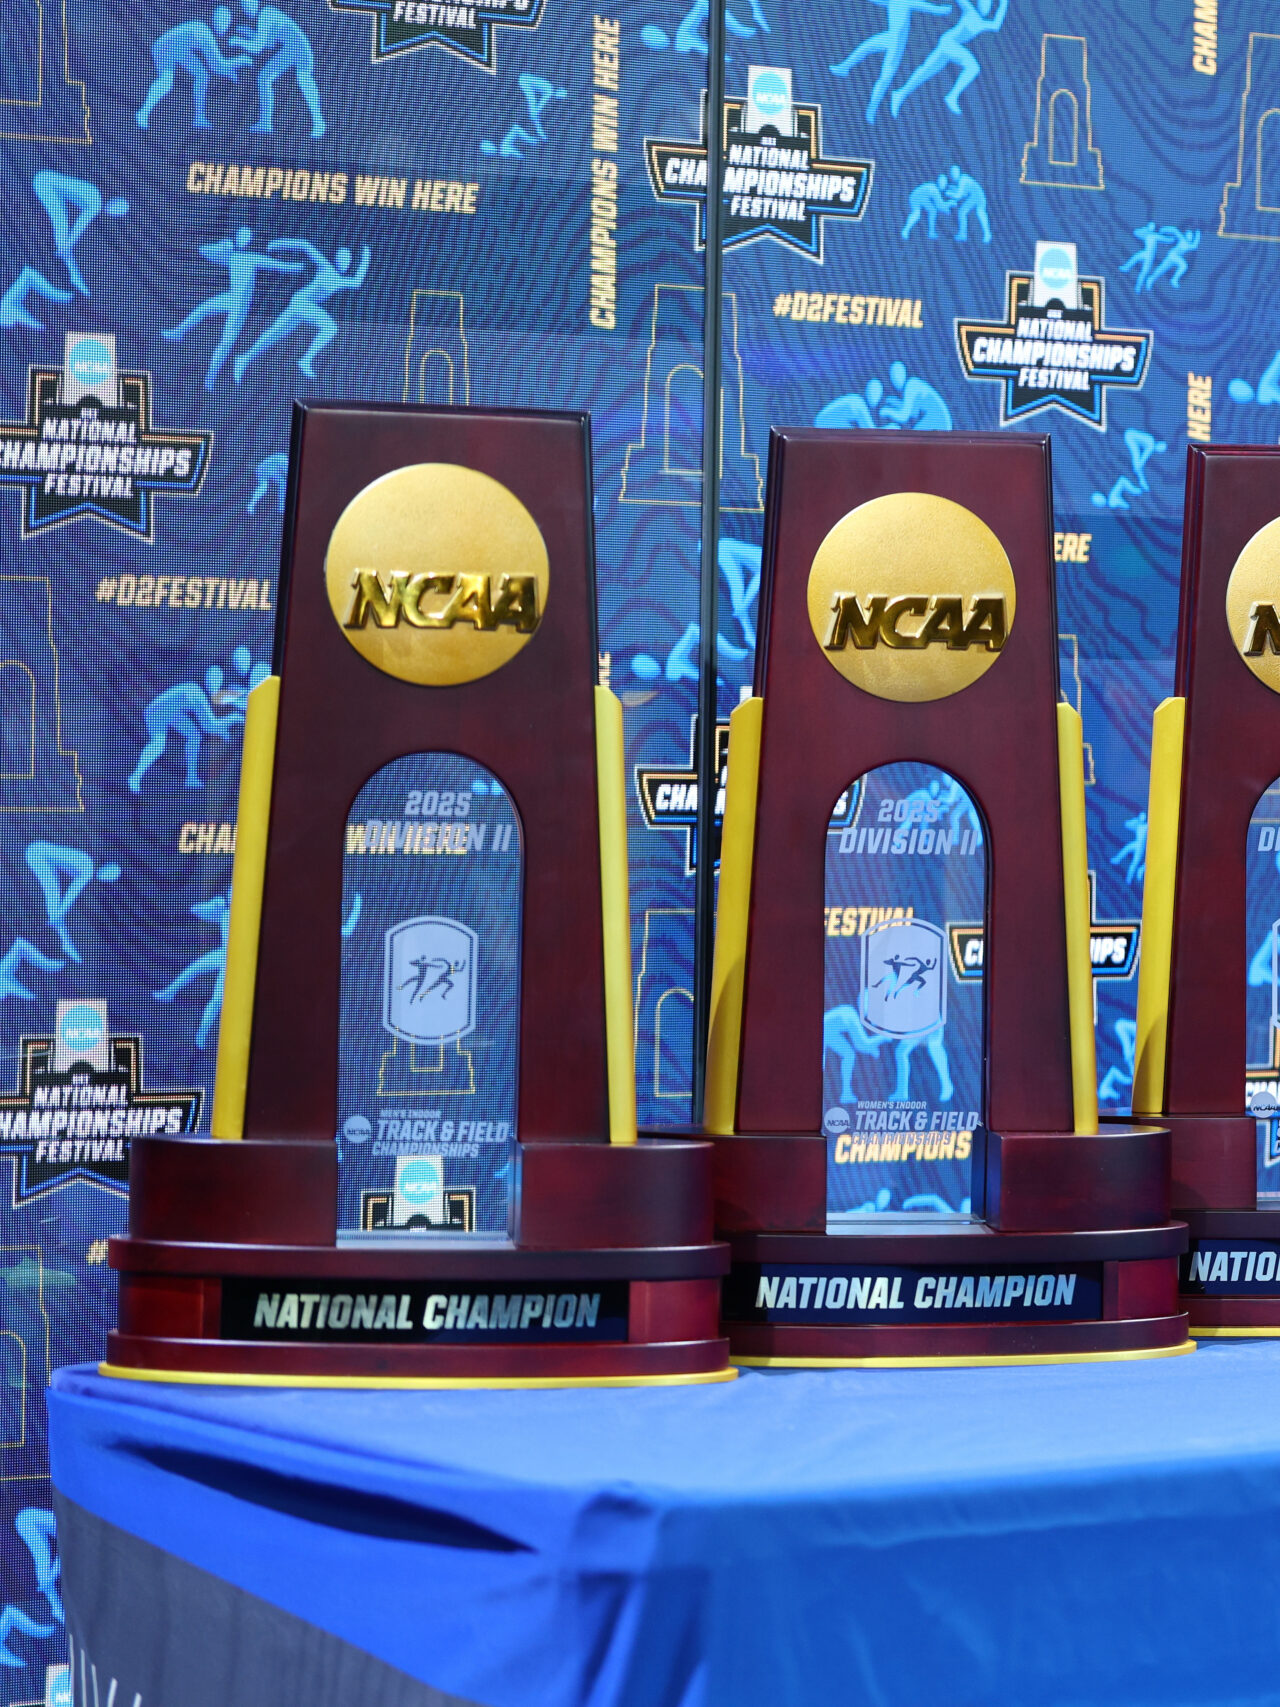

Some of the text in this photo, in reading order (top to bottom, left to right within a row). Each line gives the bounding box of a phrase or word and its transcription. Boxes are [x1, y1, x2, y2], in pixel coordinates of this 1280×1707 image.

[394, 2, 476, 28] FESTIVAL
[729, 144, 811, 171] NATIONAL
[590, 14, 621, 330] CHAMPIONS WIN HERE
[665, 157, 856, 203] CHAMPIONSHIPS
[187, 161, 480, 214] CHAMPIONS WIN HERE
[731, 195, 806, 221] FESTIVAL
[773, 292, 923, 329] #D2FESTIVAL
[1017, 317, 1093, 342] NATIONAL
[973, 337, 1136, 371] CHAMPIONSHIPS
[1018, 367, 1090, 391] FESTIVAL
[1187, 372, 1212, 442] HERE
[42, 418, 137, 444] NATIONAL
[45, 473, 135, 498] FESTIVAL
[1054, 532, 1092, 562] ERE
[96, 574, 272, 610] #D2FESTIVAL
[343, 567, 542, 634] NCAA
[823, 591, 1008, 652] NCAA
[404, 790, 472, 817] 2025
[877, 799, 941, 823] 2025
[364, 819, 512, 852] DIVISION II
[838, 827, 978, 855] DIVISION II
[34, 1086, 128, 1108] NATIONAL
[858, 1100, 928, 1110] WOMEN'S INDOOR
[0, 1108, 183, 1136] HAMPIONSHIPS
[376, 1120, 510, 1143] TRACK & FIELD
[855, 1110, 979, 1131] TRACK & FIELD
[35, 1139, 125, 1163] FESTIVAL
[371, 1141, 480, 1158] CHAMPIONSHIPS
[755, 1274, 1077, 1309] NATIONAL CHAMPION
[253, 1293, 602, 1330] NATIONAL CHAMPION
